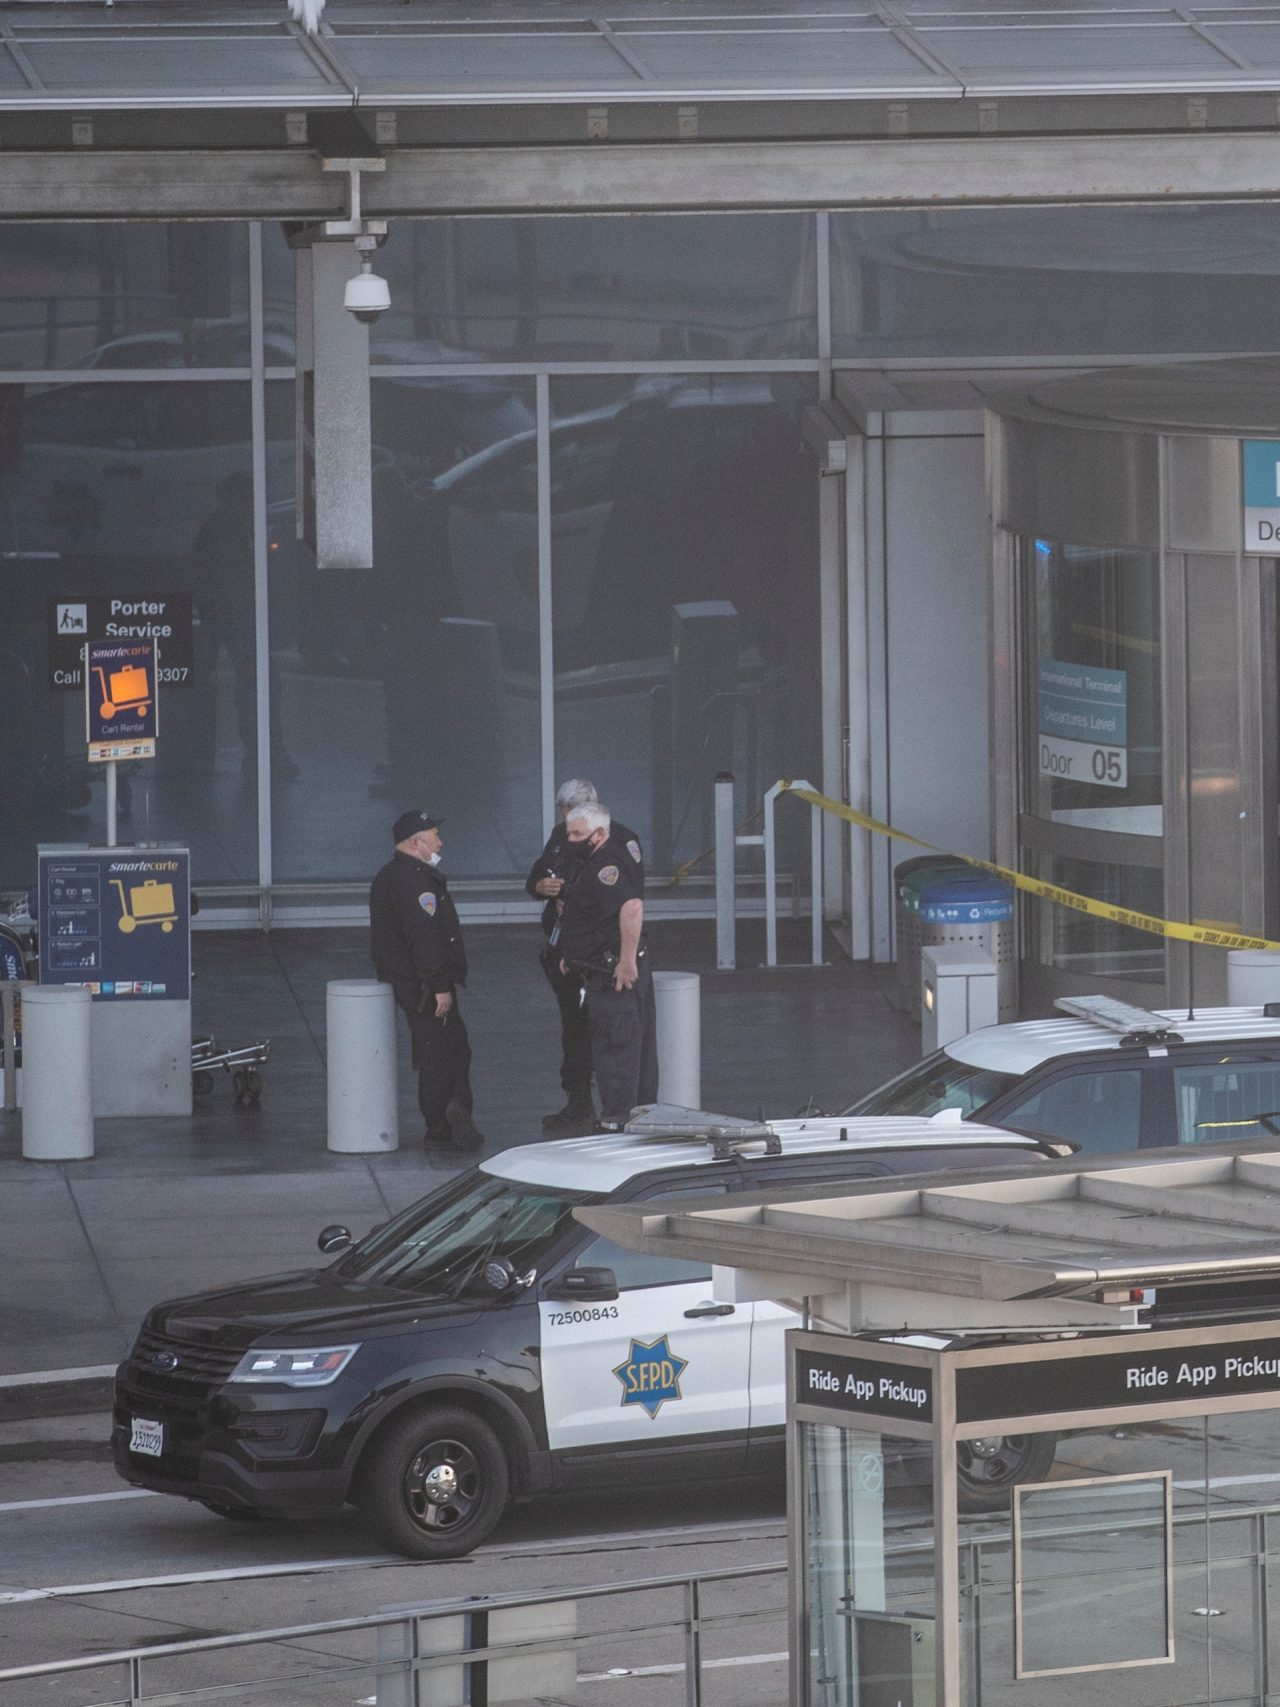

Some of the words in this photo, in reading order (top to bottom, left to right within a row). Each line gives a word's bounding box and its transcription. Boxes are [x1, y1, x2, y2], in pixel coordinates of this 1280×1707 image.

[110, 599, 167, 616] Porter
[105, 621, 173, 638] Service
[54, 669, 81, 685] Call
[1084, 676, 1121, 693] Terminal
[101, 724, 119, 734] Cart
[1090, 714, 1116, 731] Level
[1041, 743, 1072, 774] Door
[1092, 749, 1122, 782] 05
[109, 859, 178, 873] smartecarte
[548, 1306, 619, 1326] 72500843
[1126, 1366, 1169, 1389] Ride
[1176, 1363, 1217, 1386] App
[809, 1368, 840, 1392] Ride
[844, 1374, 875, 1401] App
[879, 1378, 927, 1408] Pickup
